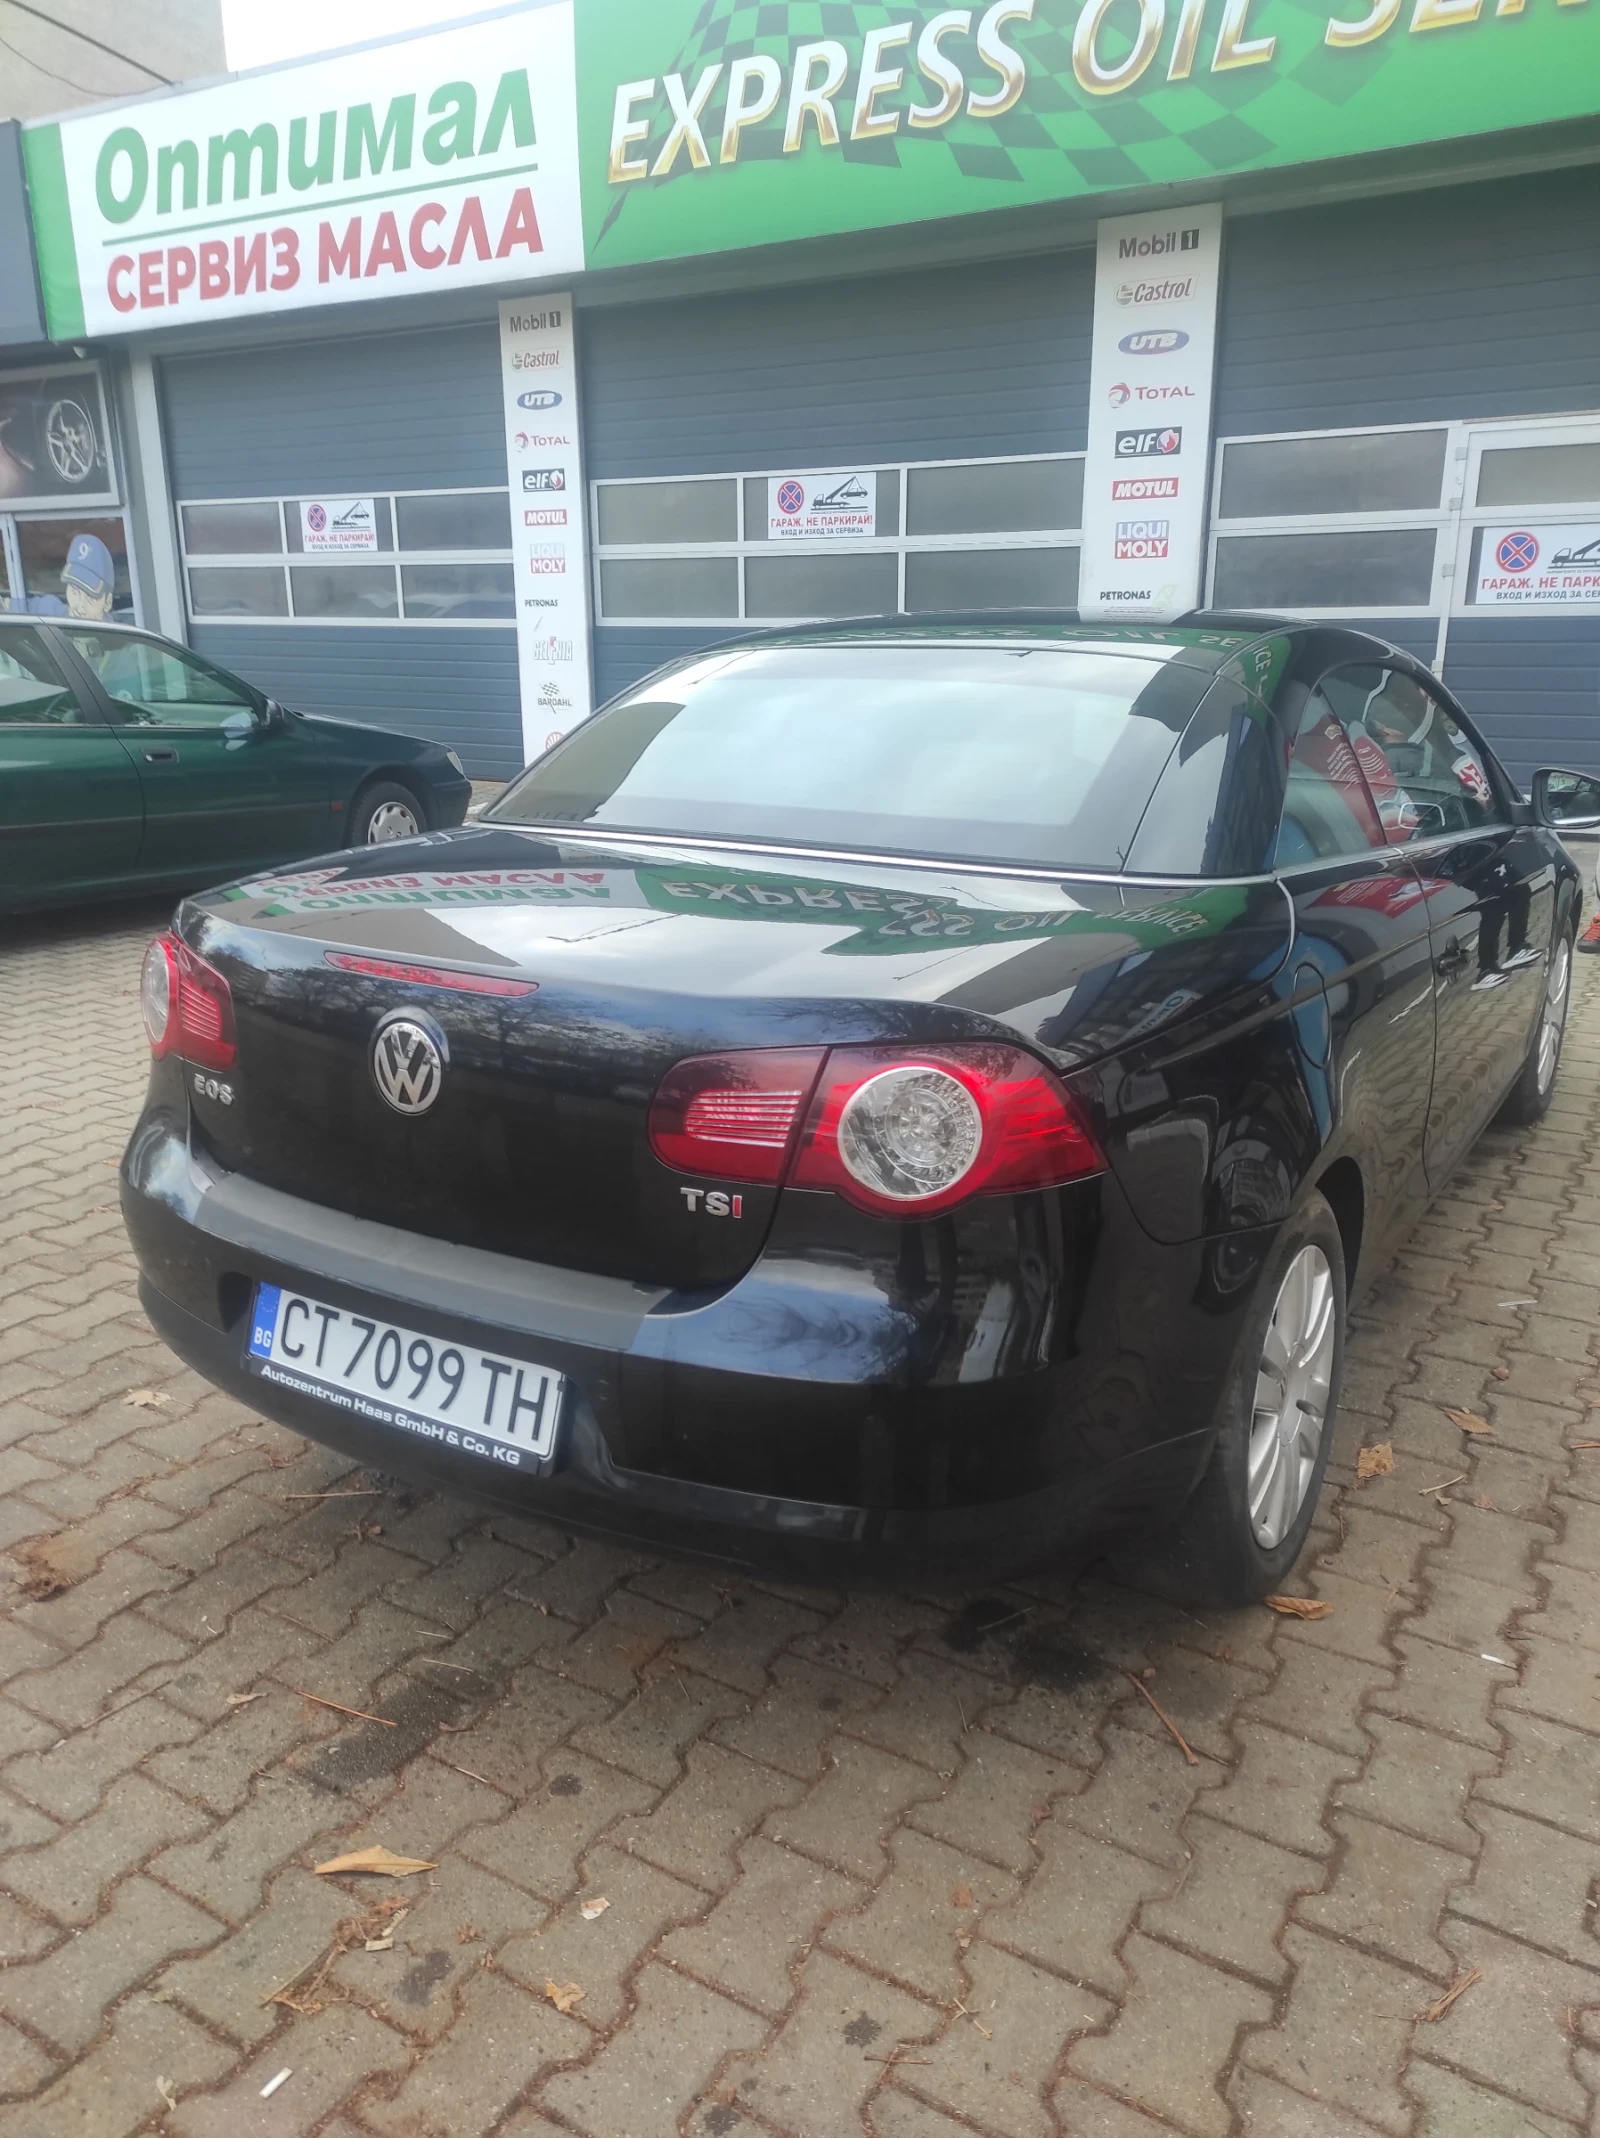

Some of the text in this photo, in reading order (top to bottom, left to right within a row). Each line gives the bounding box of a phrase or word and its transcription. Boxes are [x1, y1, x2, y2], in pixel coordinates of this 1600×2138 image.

[608, 0, 1276, 184] EXPRESS OIL
[96, 68, 538, 225] Оптимал
[107, 187, 545, 313] СЕРВИЗ МАСЛА
[1119, 232, 1176, 259] Mobil
[1134, 277, 1193, 303] Castrol
[510, 313, 546, 333] Mobil
[1129, 332, 1179, 350] UTB
[524, 350, 560, 368] Castrol
[1135, 386, 1196, 400] TOTAL
[531, 434, 570, 447] TOTAL
[1118, 432, 1157, 454] elf
[525, 472, 549, 489] elf
[1114, 480, 1176, 498] MOTUL
[526, 510, 566, 525] MOTUL
[771, 513, 873, 528] ГАРАЖ. НЕ ПАРКИРАЙ!
[1117, 521, 1167, 540] LIQUI
[1116, 540, 1168, 558] MOLY
[531, 558, 565, 573] MOLY
[1482, 578, 1533, 589] ГАРАЖ.
[1539, 577, 1558, 588] НЕ
[524, 599, 558, 607] PETRONAS
[1100, 590, 1151, 600] PETRONAS
[1496, 592, 1522, 600] ВХОД
[1534, 591, 1567, 600] ИЗХОД
[538, 698, 572, 707] BARDAHL
[194, 1073, 234, 1105] EOS
[680, 1187, 742, 1218] TSI
[254, 1326, 272, 1348] BG
[261, 1365, 520, 1465] Autozentrum Haas GmbH & Co. KG
